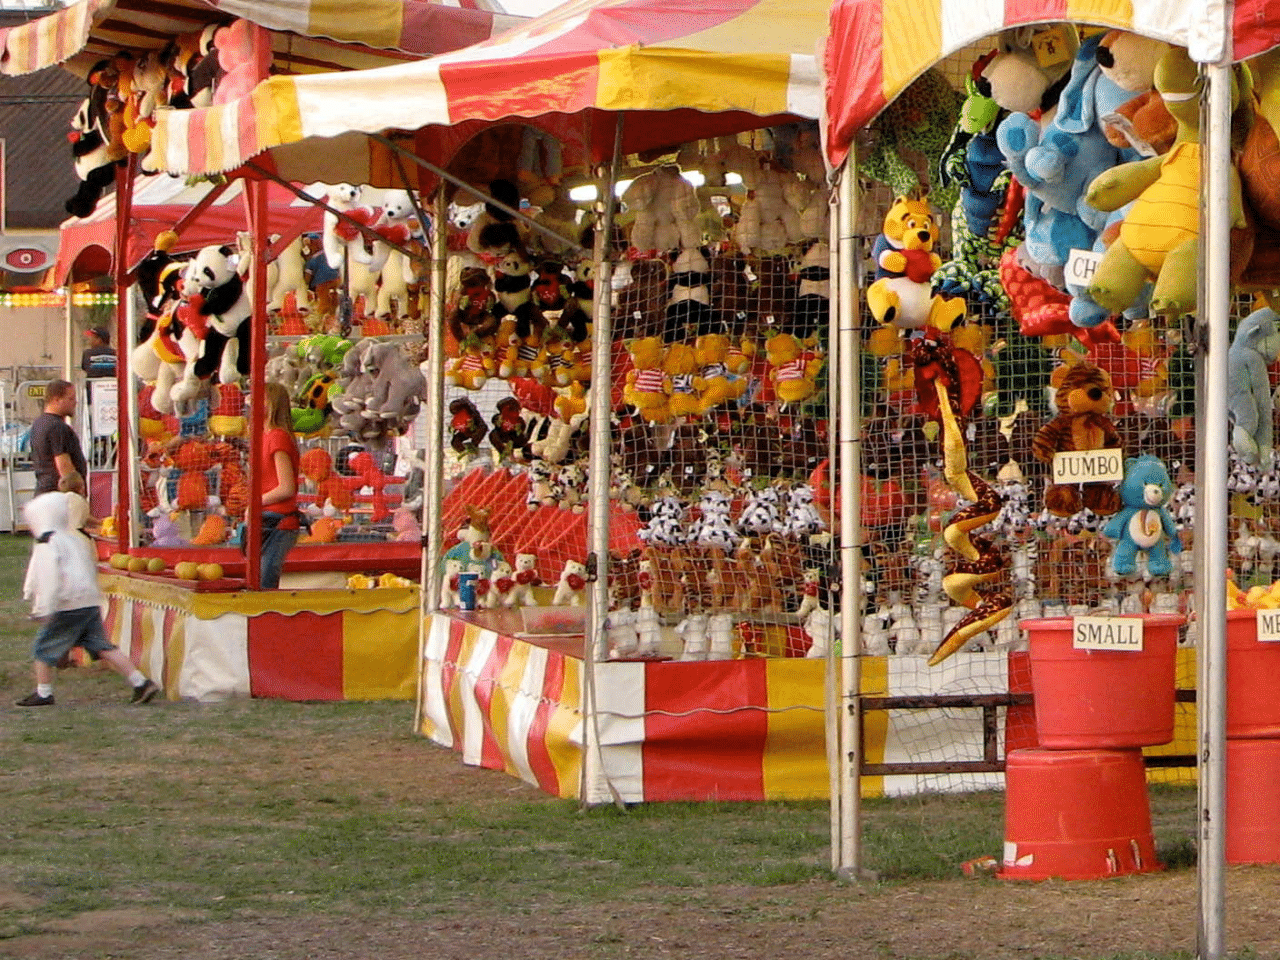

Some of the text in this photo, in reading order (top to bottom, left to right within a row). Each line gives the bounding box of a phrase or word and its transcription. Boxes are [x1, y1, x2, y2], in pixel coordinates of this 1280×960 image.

[1073, 256, 1097, 279] CH
[1057, 455, 1119, 477] JUMBO
[1077, 623, 1139, 645] SMALL
